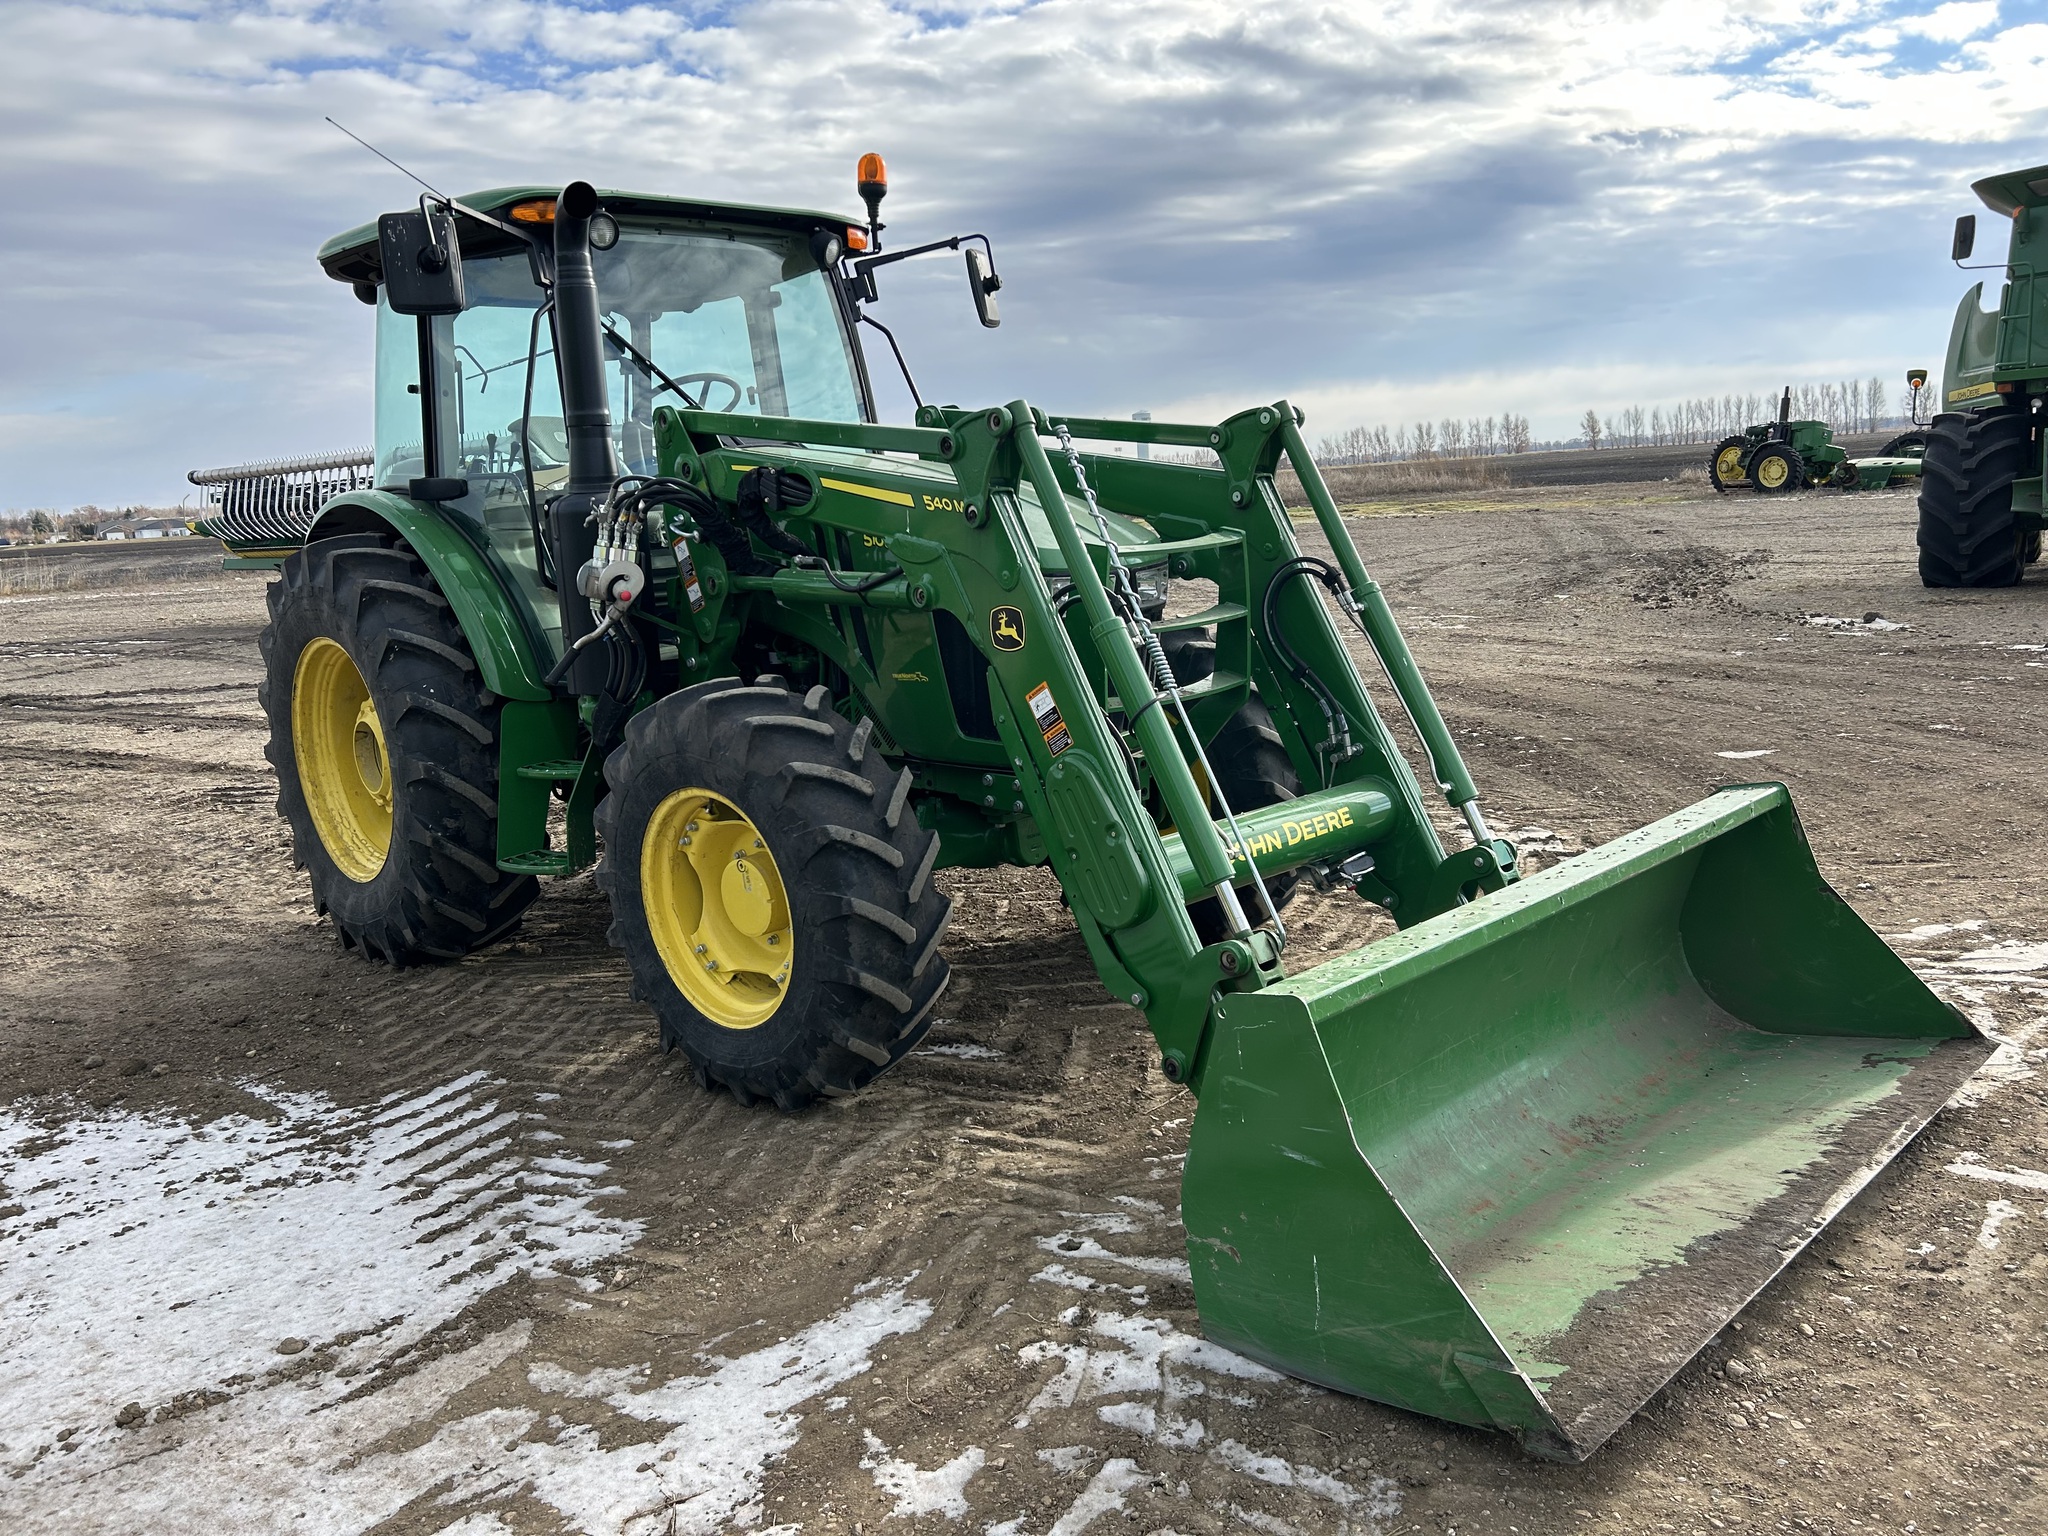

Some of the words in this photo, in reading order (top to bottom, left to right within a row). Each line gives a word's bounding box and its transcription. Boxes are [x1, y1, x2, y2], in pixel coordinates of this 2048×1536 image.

[1967, 388, 1980, 398] DEERE
[922, 495, 952, 511] 540
[863, 534, 889, 549] 510
[1230, 830, 1282, 864] OHN
[1281, 806, 1354, 846] DEERE
